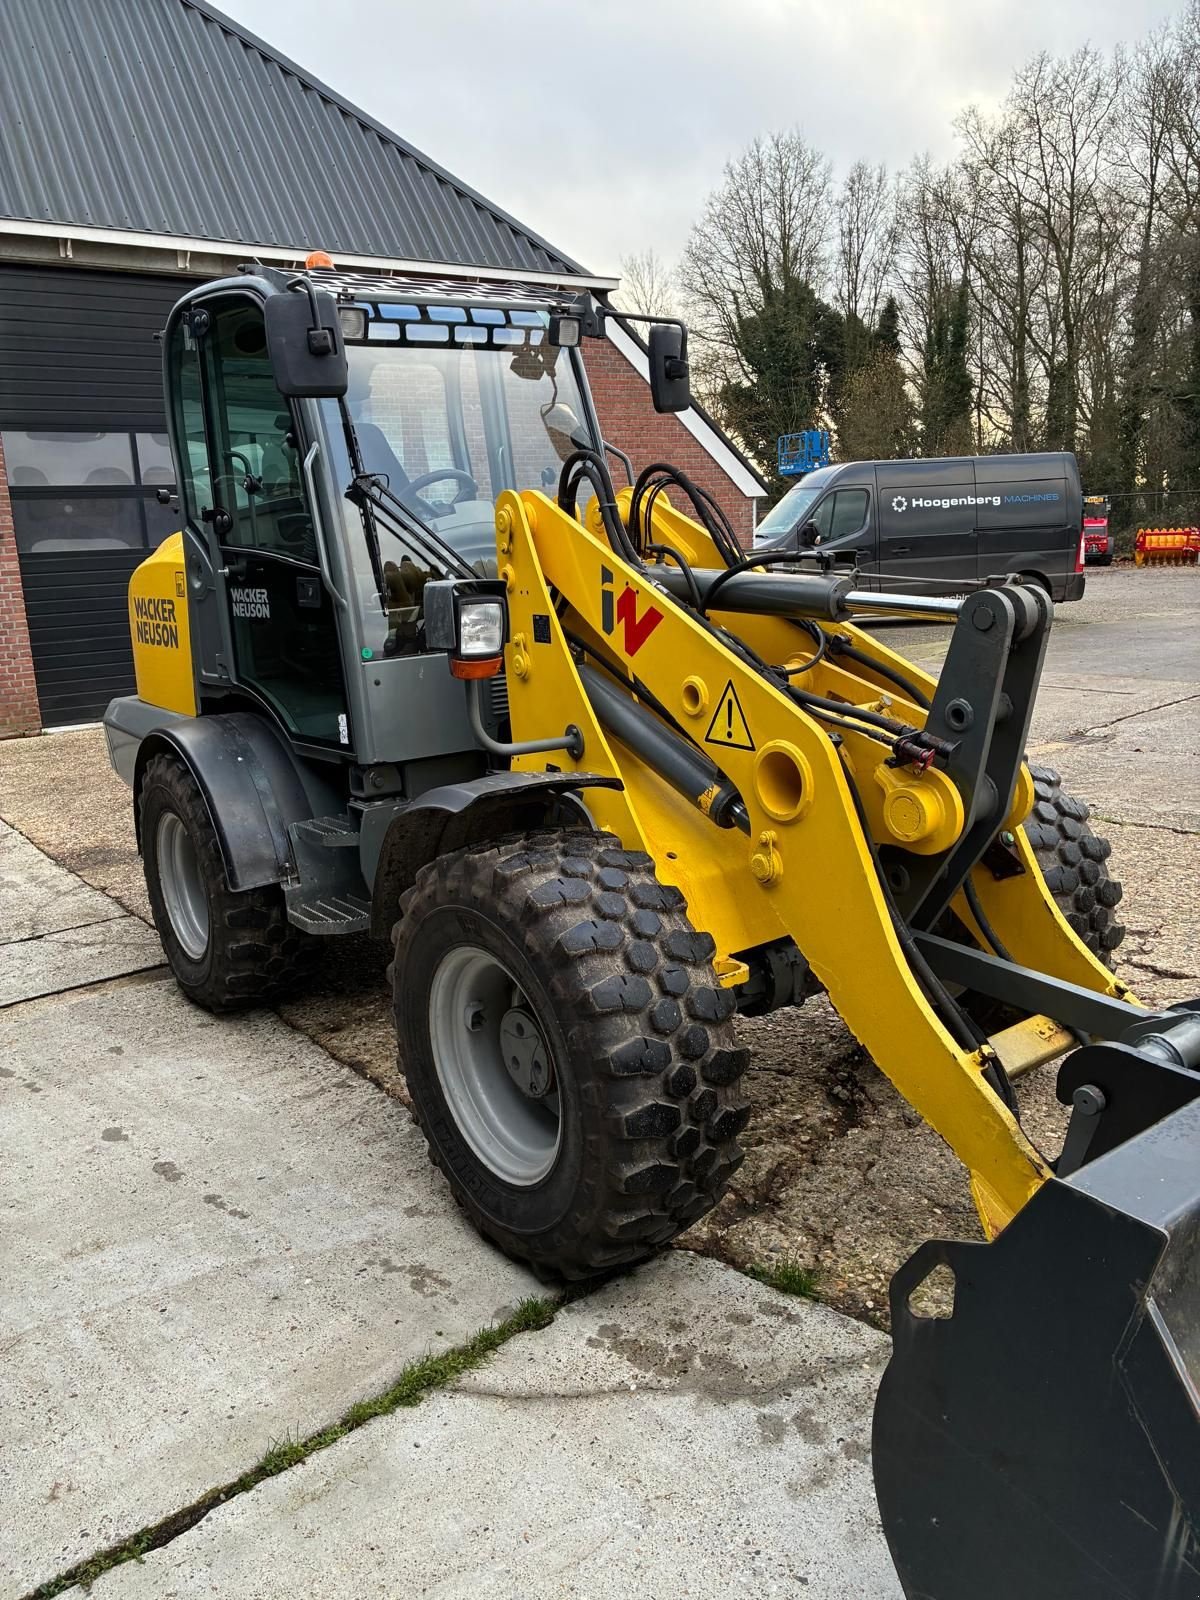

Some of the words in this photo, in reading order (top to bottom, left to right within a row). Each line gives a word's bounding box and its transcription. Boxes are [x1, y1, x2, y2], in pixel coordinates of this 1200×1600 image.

[912, 496, 1001, 508] Hoogenberg
[1004, 493, 1060, 503] MACHINES
[230, 588, 269, 603] WACKER
[134, 597, 177, 623] WACKER
[232, 602, 270, 618] NEUSON
[136, 621, 179, 649] NEUSON
